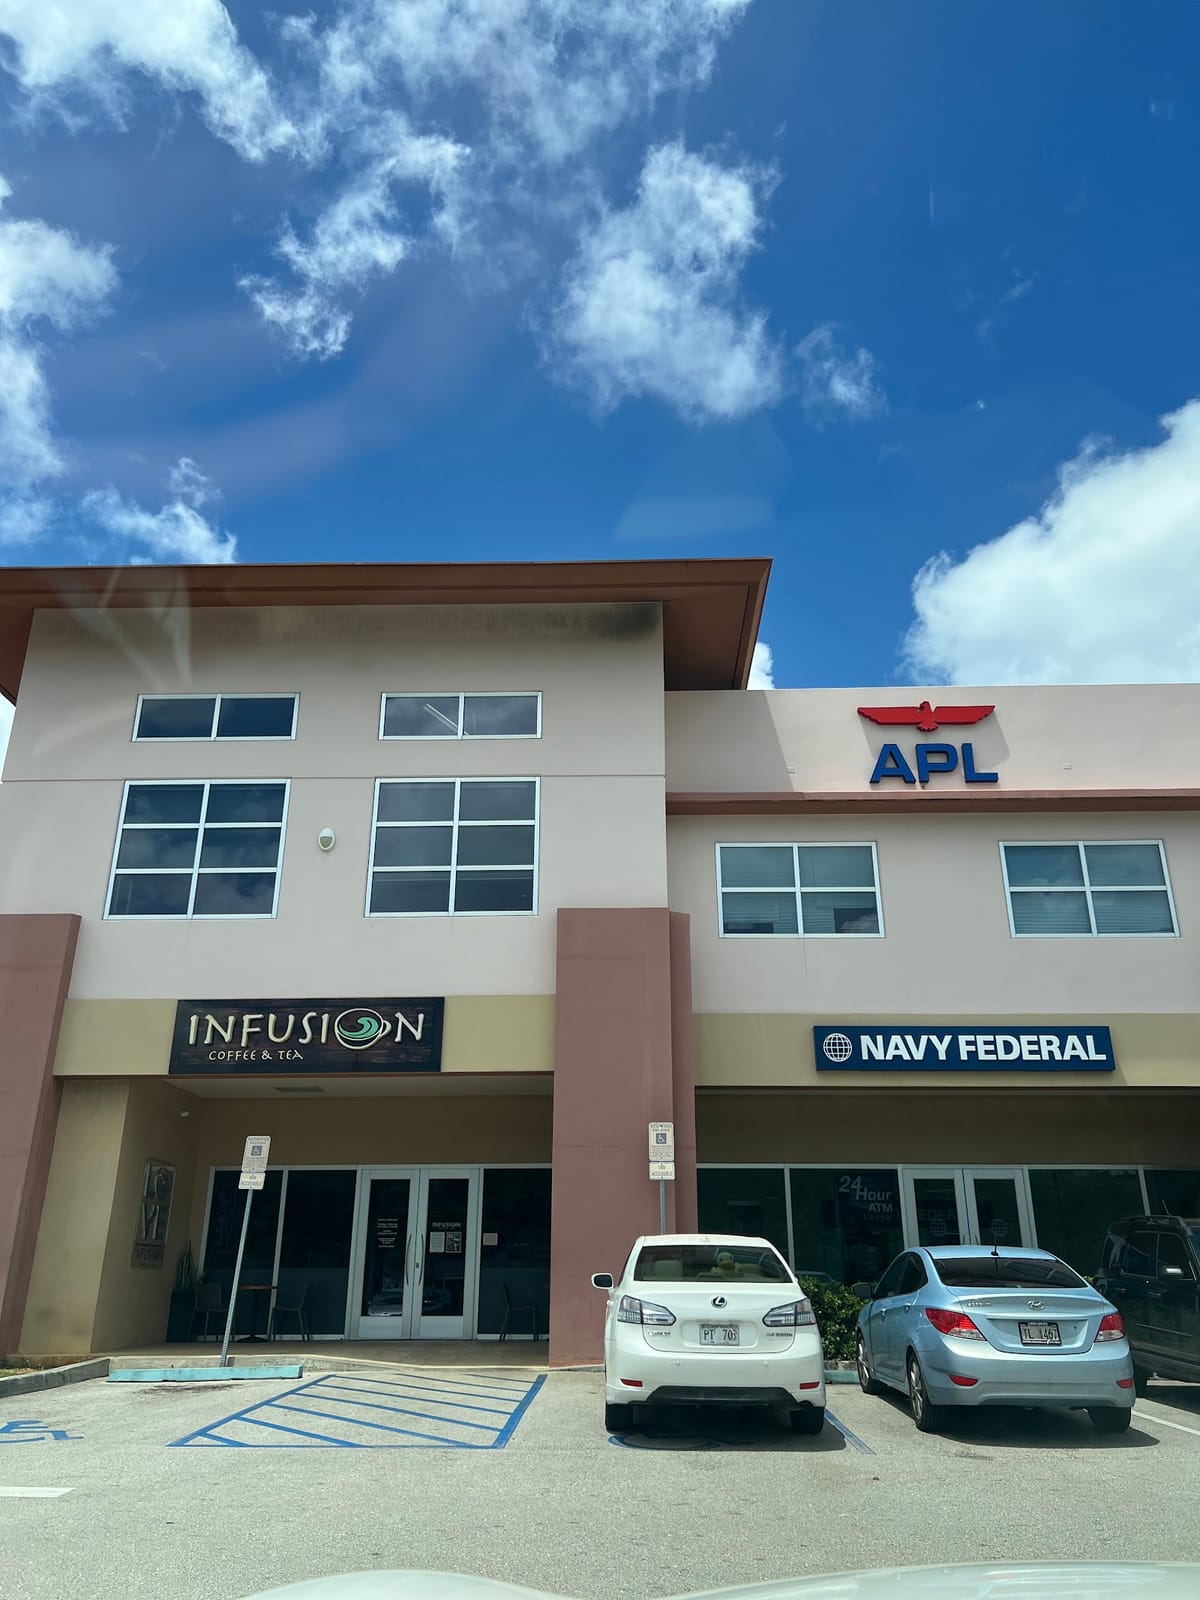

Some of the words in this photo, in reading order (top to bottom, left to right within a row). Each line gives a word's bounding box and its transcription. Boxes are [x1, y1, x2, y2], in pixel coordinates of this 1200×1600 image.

[869, 743, 999, 784] APL
[188, 1008, 425, 1050] INFUSION
[208, 1050, 257, 1061] COFFEE
[261, 1050, 273, 1061] &
[278, 1050, 304, 1061] TEA
[860, 1035, 952, 1061] NAVY
[957, 1035, 1107, 1061] FEDERAL
[838, 1175, 863, 1193] 24
[855, 1187, 893, 1201] Hour
[868, 1202, 893, 1213] ATM
